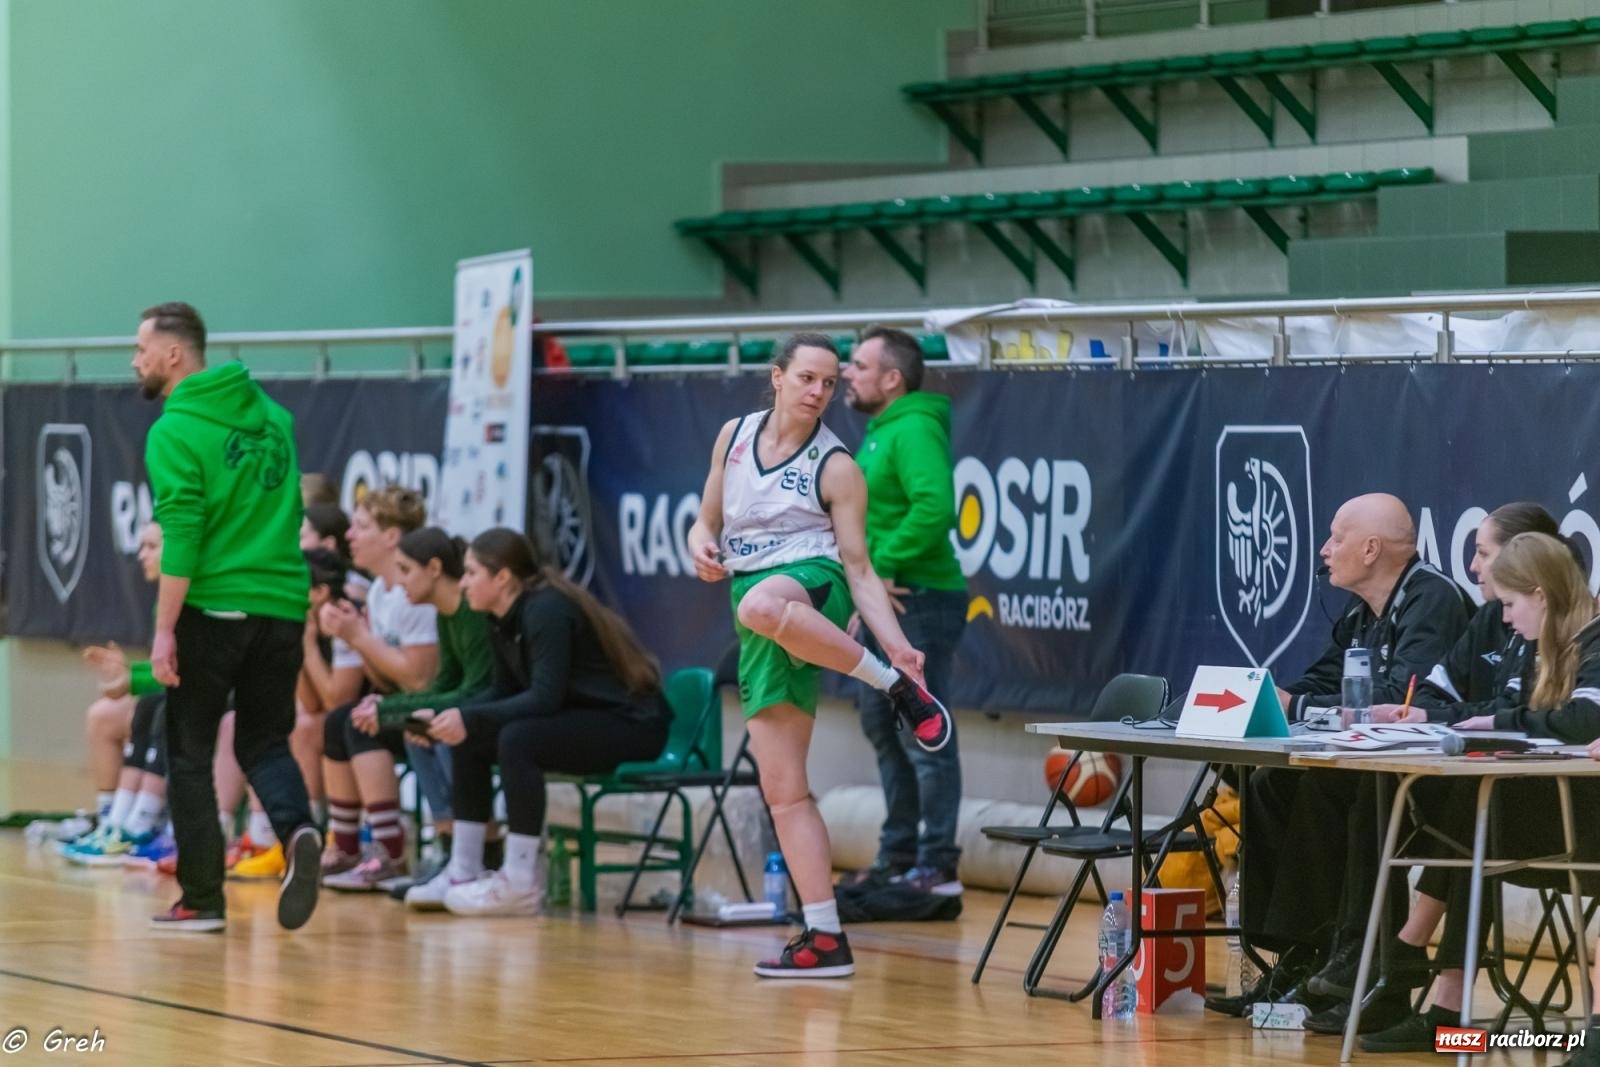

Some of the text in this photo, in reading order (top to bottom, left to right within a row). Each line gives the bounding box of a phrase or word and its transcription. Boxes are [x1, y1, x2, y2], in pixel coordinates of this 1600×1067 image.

[781, 467, 813, 496] 33
[949, 456, 1092, 584] OSiR
[998, 586, 1091, 632] RACIBÓRZ
[1163, 903, 1198, 983] 5
